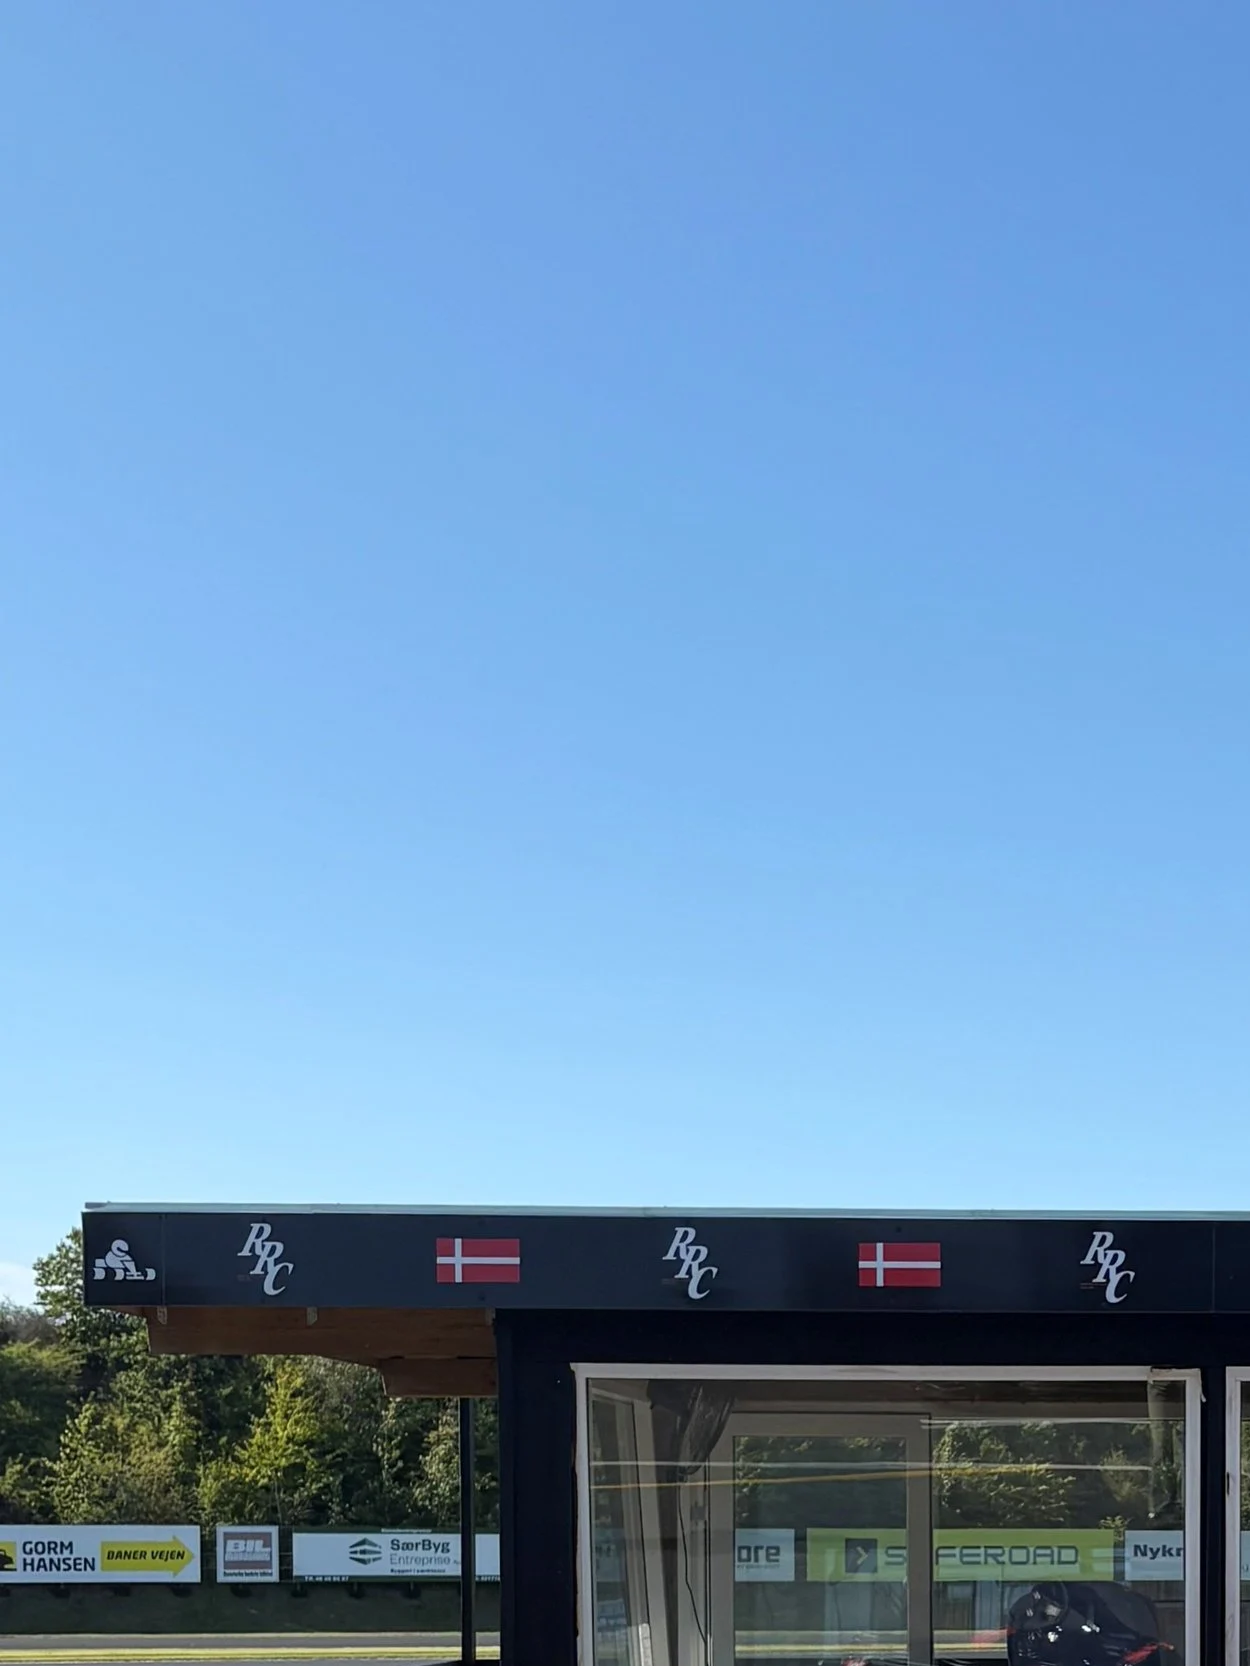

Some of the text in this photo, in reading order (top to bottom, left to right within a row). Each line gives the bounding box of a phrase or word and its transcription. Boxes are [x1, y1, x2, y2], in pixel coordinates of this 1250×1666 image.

[237, 1223, 294, 1296] RRC
[662, 1227, 718, 1299] RRC
[1080, 1231, 1135, 1303] RRC
[22, 1541, 73, 1555] GORM
[225, 1539, 271, 1552] BIL
[390, 1539, 450, 1554] SærByg
[150, 1550, 185, 1562] VEJEN
[390, 1553, 450, 1567] Entreprise
[885, 1545, 1079, 1565] SFEROAD
[22, 1557, 96, 1572] HANSEN
